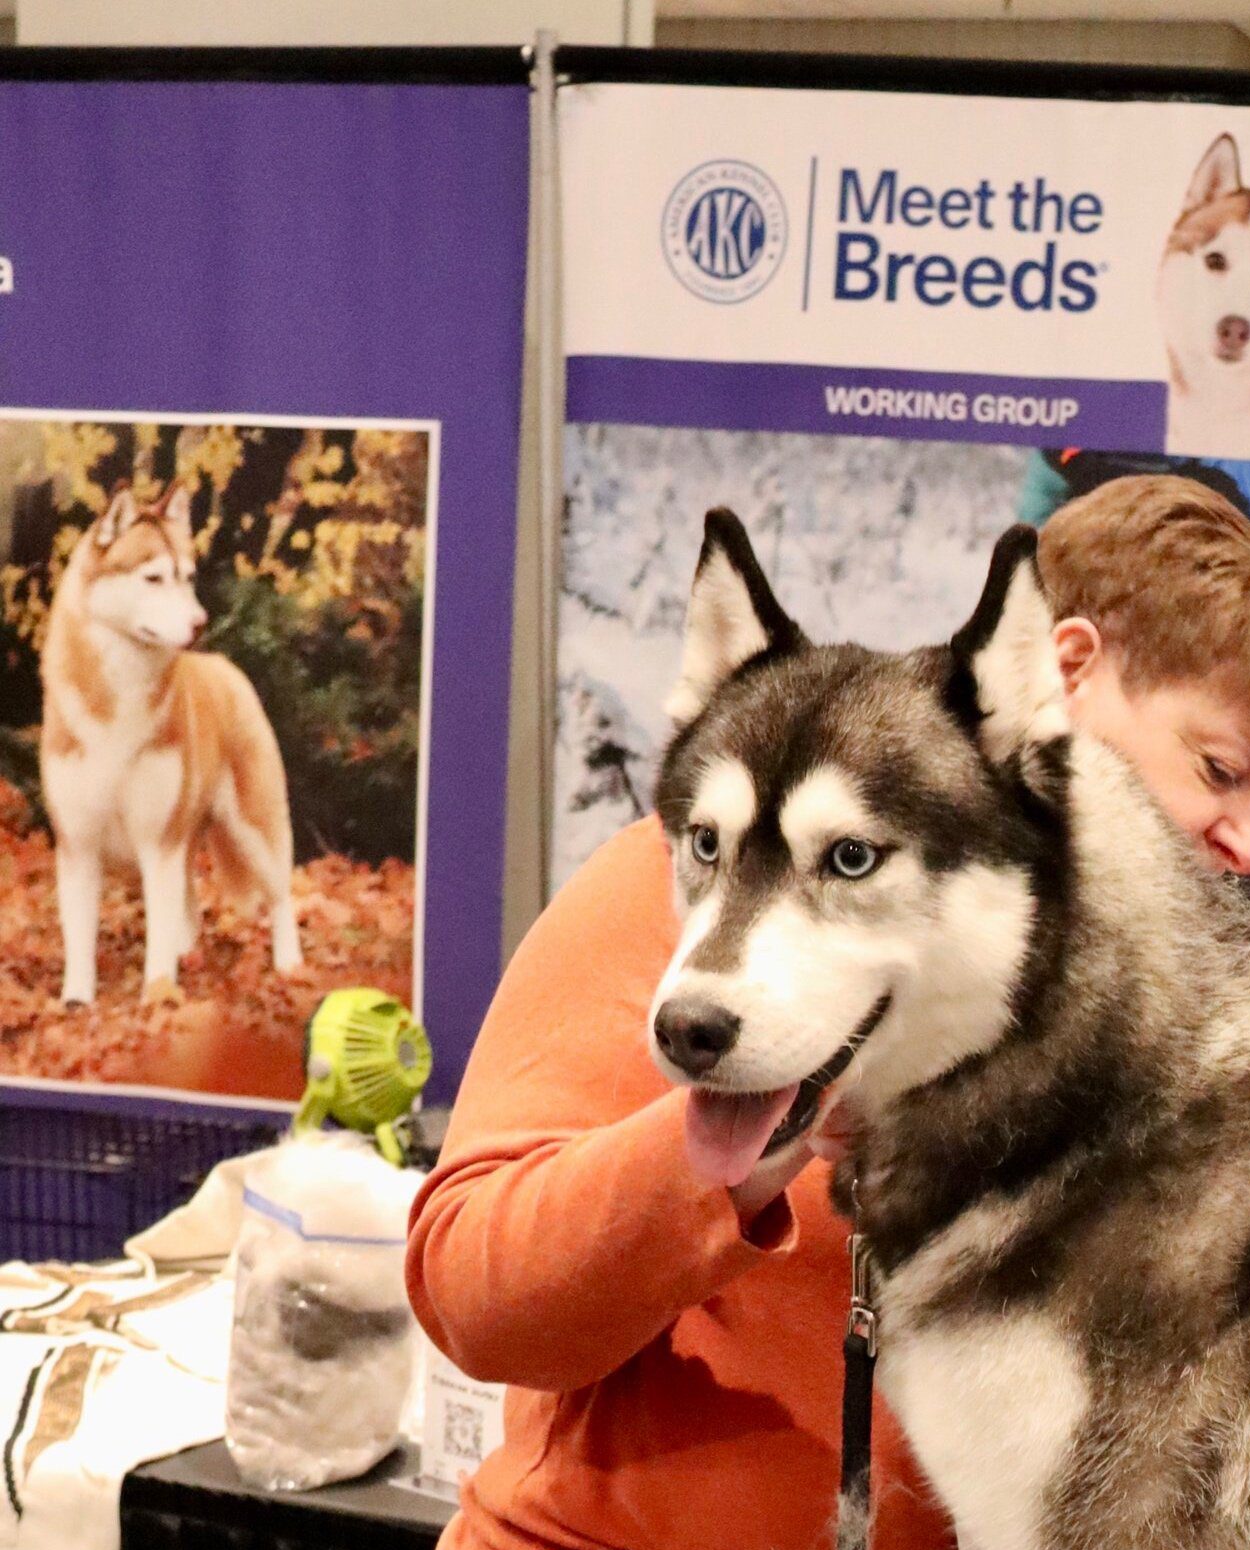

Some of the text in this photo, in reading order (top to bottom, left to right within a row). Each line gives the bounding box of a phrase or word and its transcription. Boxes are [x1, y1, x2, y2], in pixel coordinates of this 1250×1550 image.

[687, 188, 766, 280] AKC
[837, 168, 995, 230] Meet
[1010, 177, 1102, 234] the
[832, 231, 1099, 312] Breeds
[824, 386, 1079, 427] WORKING GROUP
